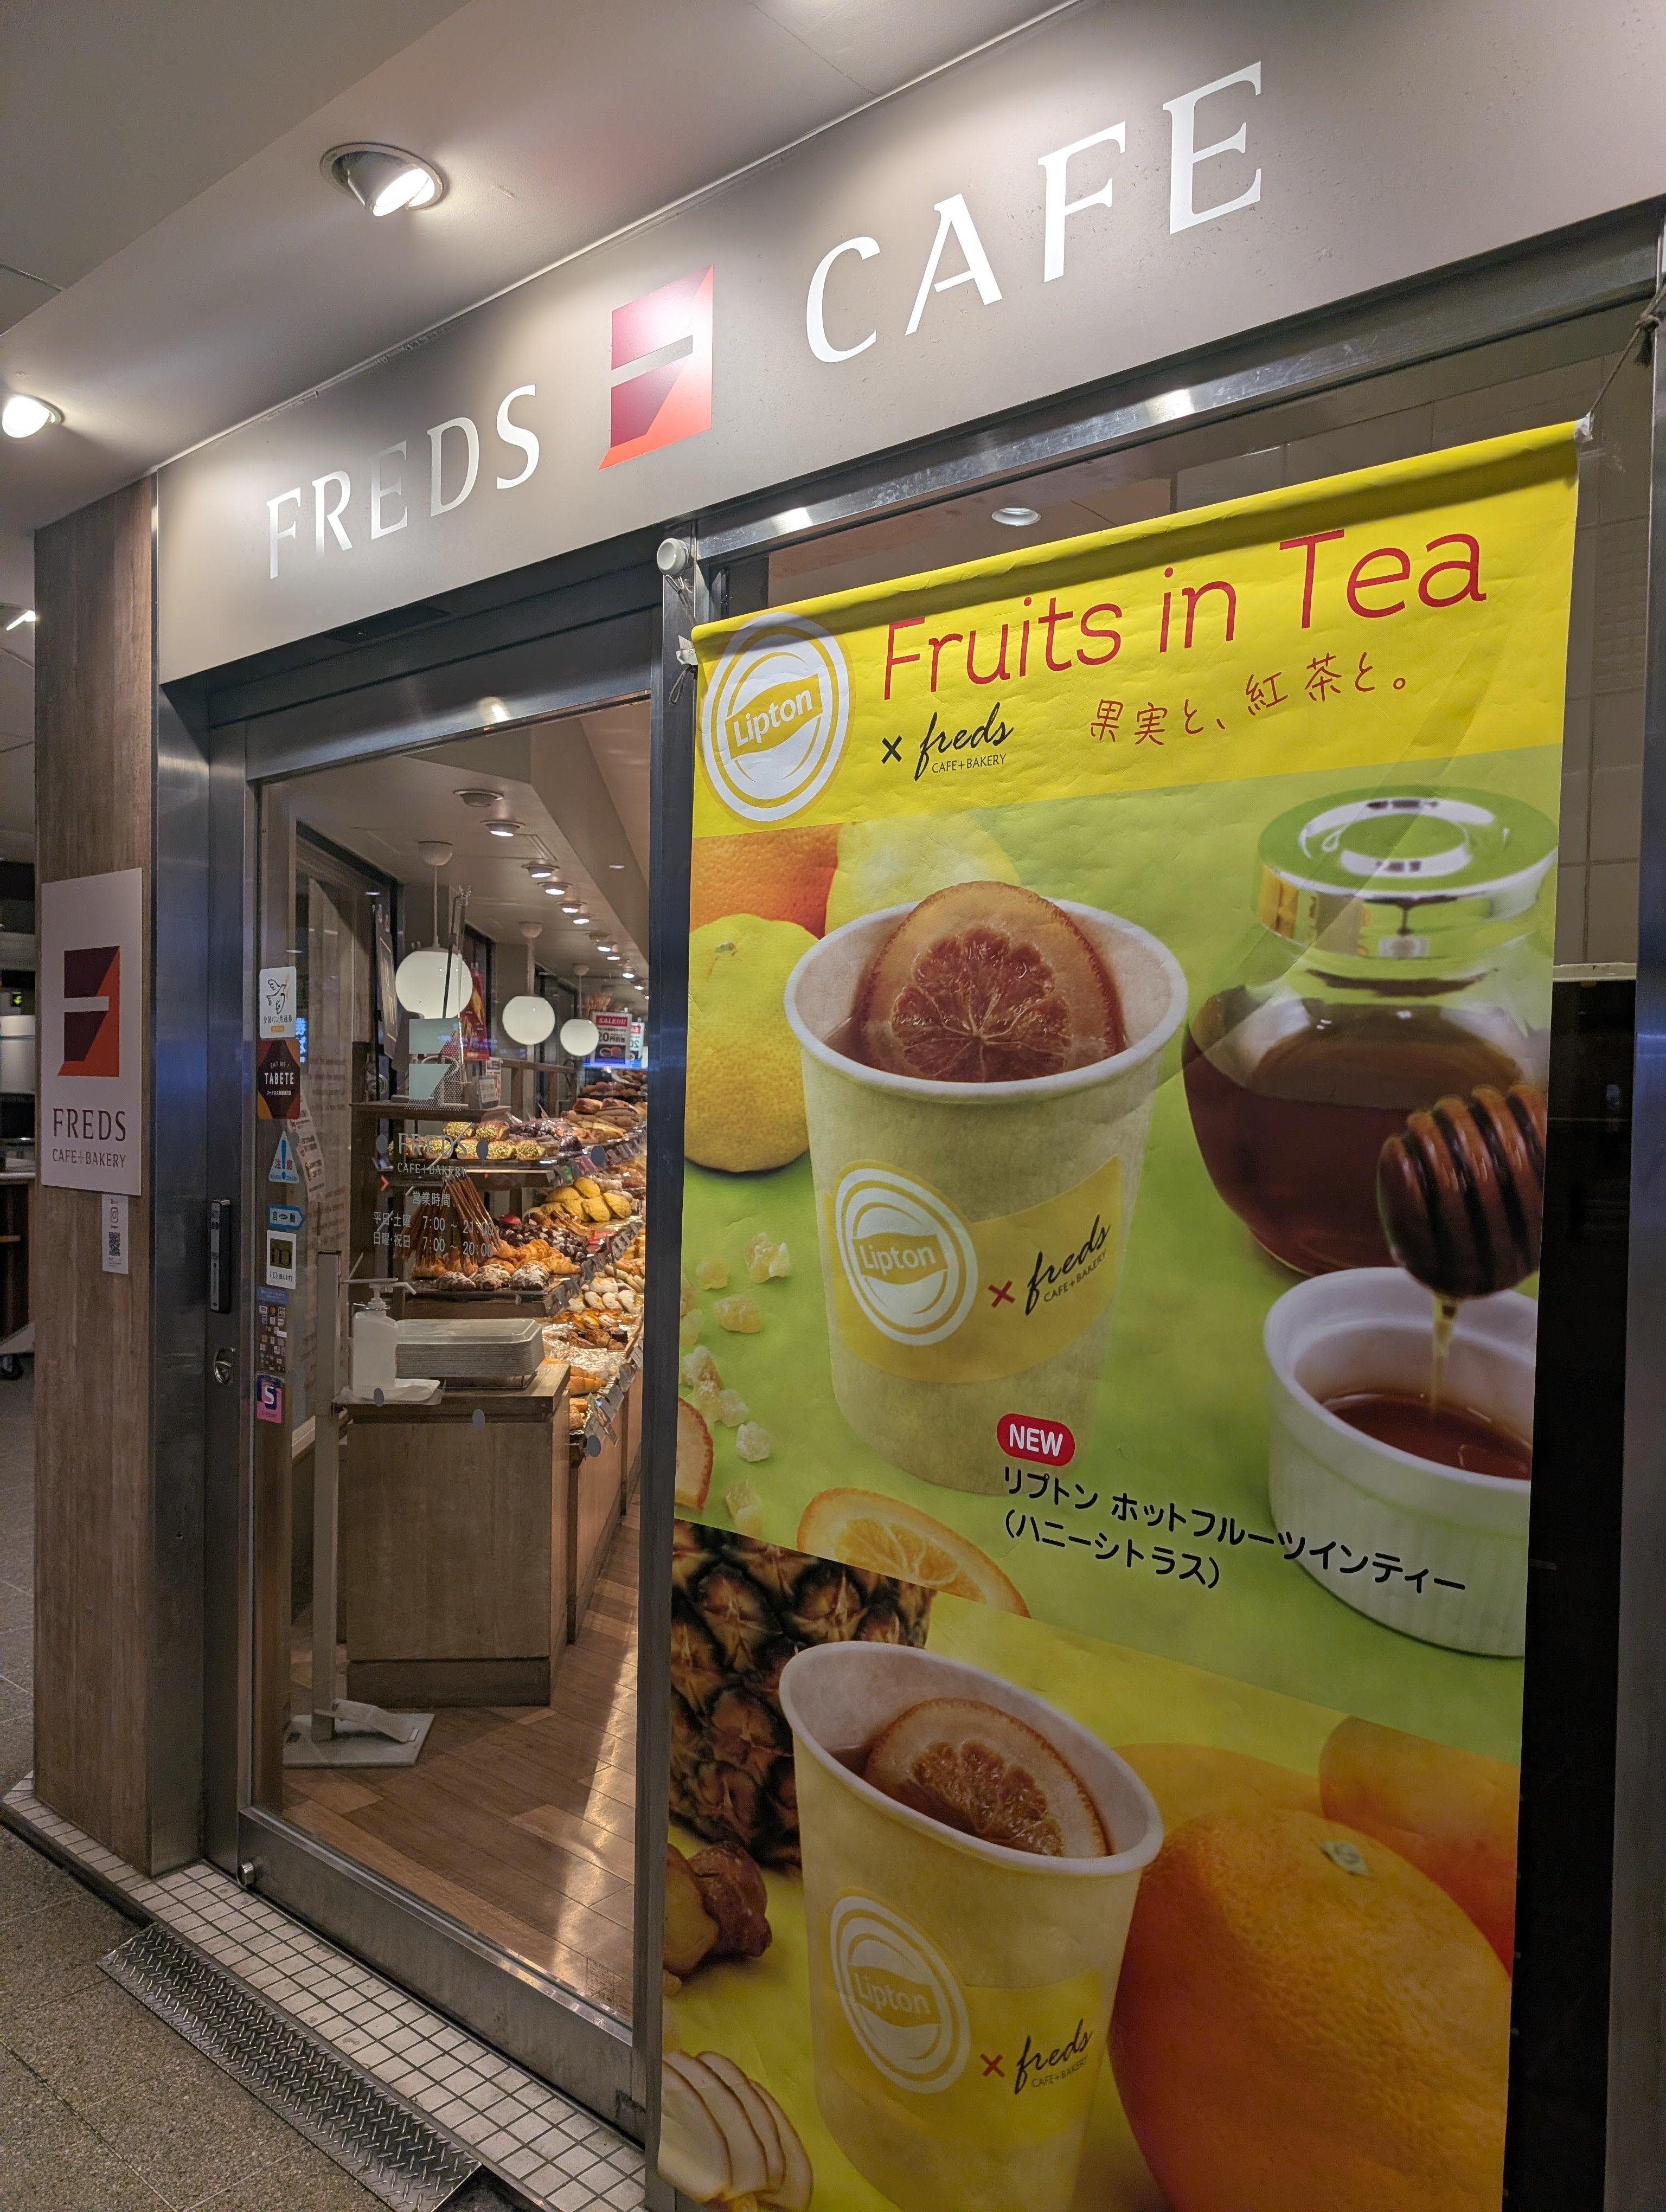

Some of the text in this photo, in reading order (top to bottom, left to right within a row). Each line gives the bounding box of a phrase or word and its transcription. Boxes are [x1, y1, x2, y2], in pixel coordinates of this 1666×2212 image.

[266, 61, 1261, 579] FREDS CAFE
[884, 529, 1487, 700] Fruits in Tea
[732, 688, 814, 748] Lipton
[914, 702, 1014, 782] freds
[931, 753, 1007, 774] CAFE+BAKERY
[264, 1072, 294, 1085] TABETE
[53, 1108, 126, 1142] FREDS
[52, 1148, 126, 1168] CAFE+BAKERY
[398, 1133, 467, 1159] FREDS
[412, 1191, 450, 1208] 営業時間
[422, 1216, 445, 1231] 7:00
[463, 1220, 494, 1236] 21:00
[271, 1247, 292, 1267] iD
[422, 1236, 445, 1252] 7:00
[463, 1241, 494, 1258] 20:00
[858, 1244, 936, 1275] Lipton
[1024, 1214, 1112, 1316] freds
[1043, 1250, 1107, 1303] CAFE+BAKERY
[1009, 1423, 1063, 1457] NEW
[1004, 1466, 1466, 1594] リプトン ホットフルーツインティー
[854, 1972, 931, 2015] Lipton
[1014, 2018, 1093, 2095] freds
